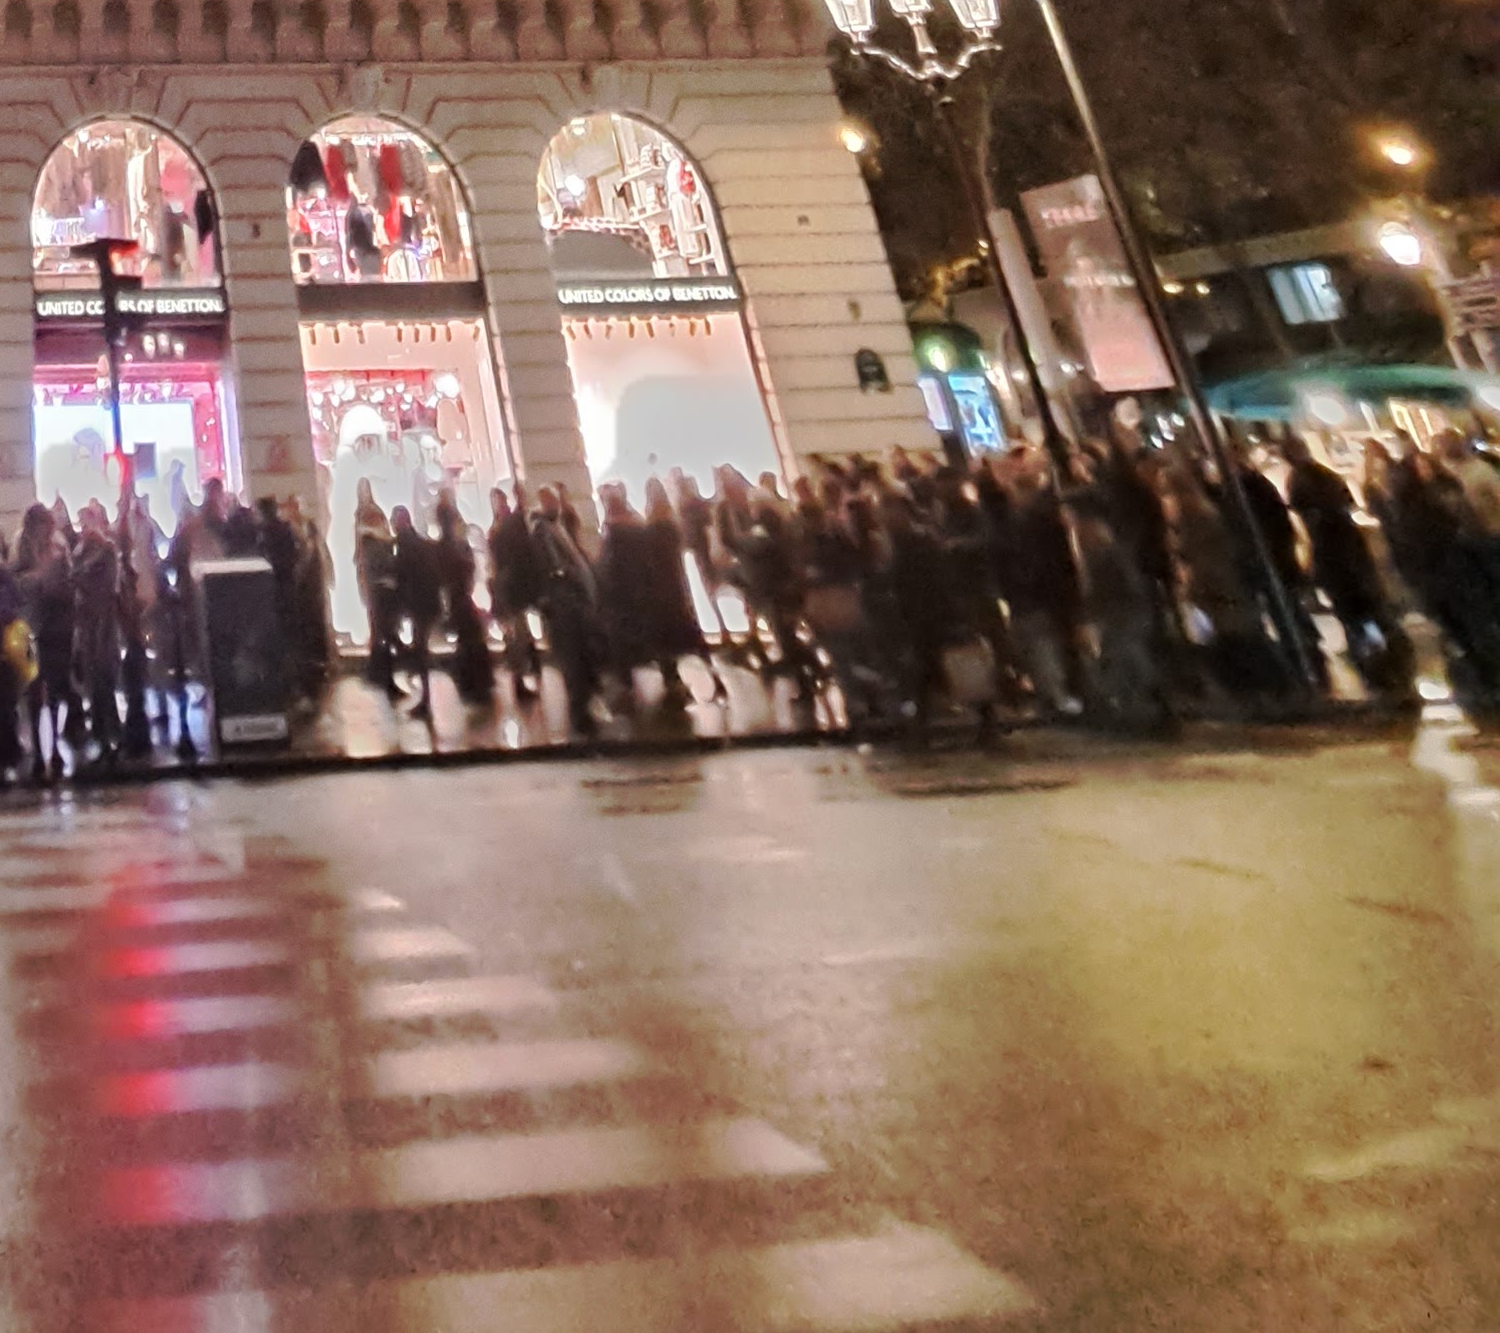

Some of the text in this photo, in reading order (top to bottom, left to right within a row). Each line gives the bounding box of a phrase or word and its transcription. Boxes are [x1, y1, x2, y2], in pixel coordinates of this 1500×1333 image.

[558, 290, 604, 305] UNITED
[605, 288, 654, 303] COLORS
[36, 301, 85, 316] UNITED
